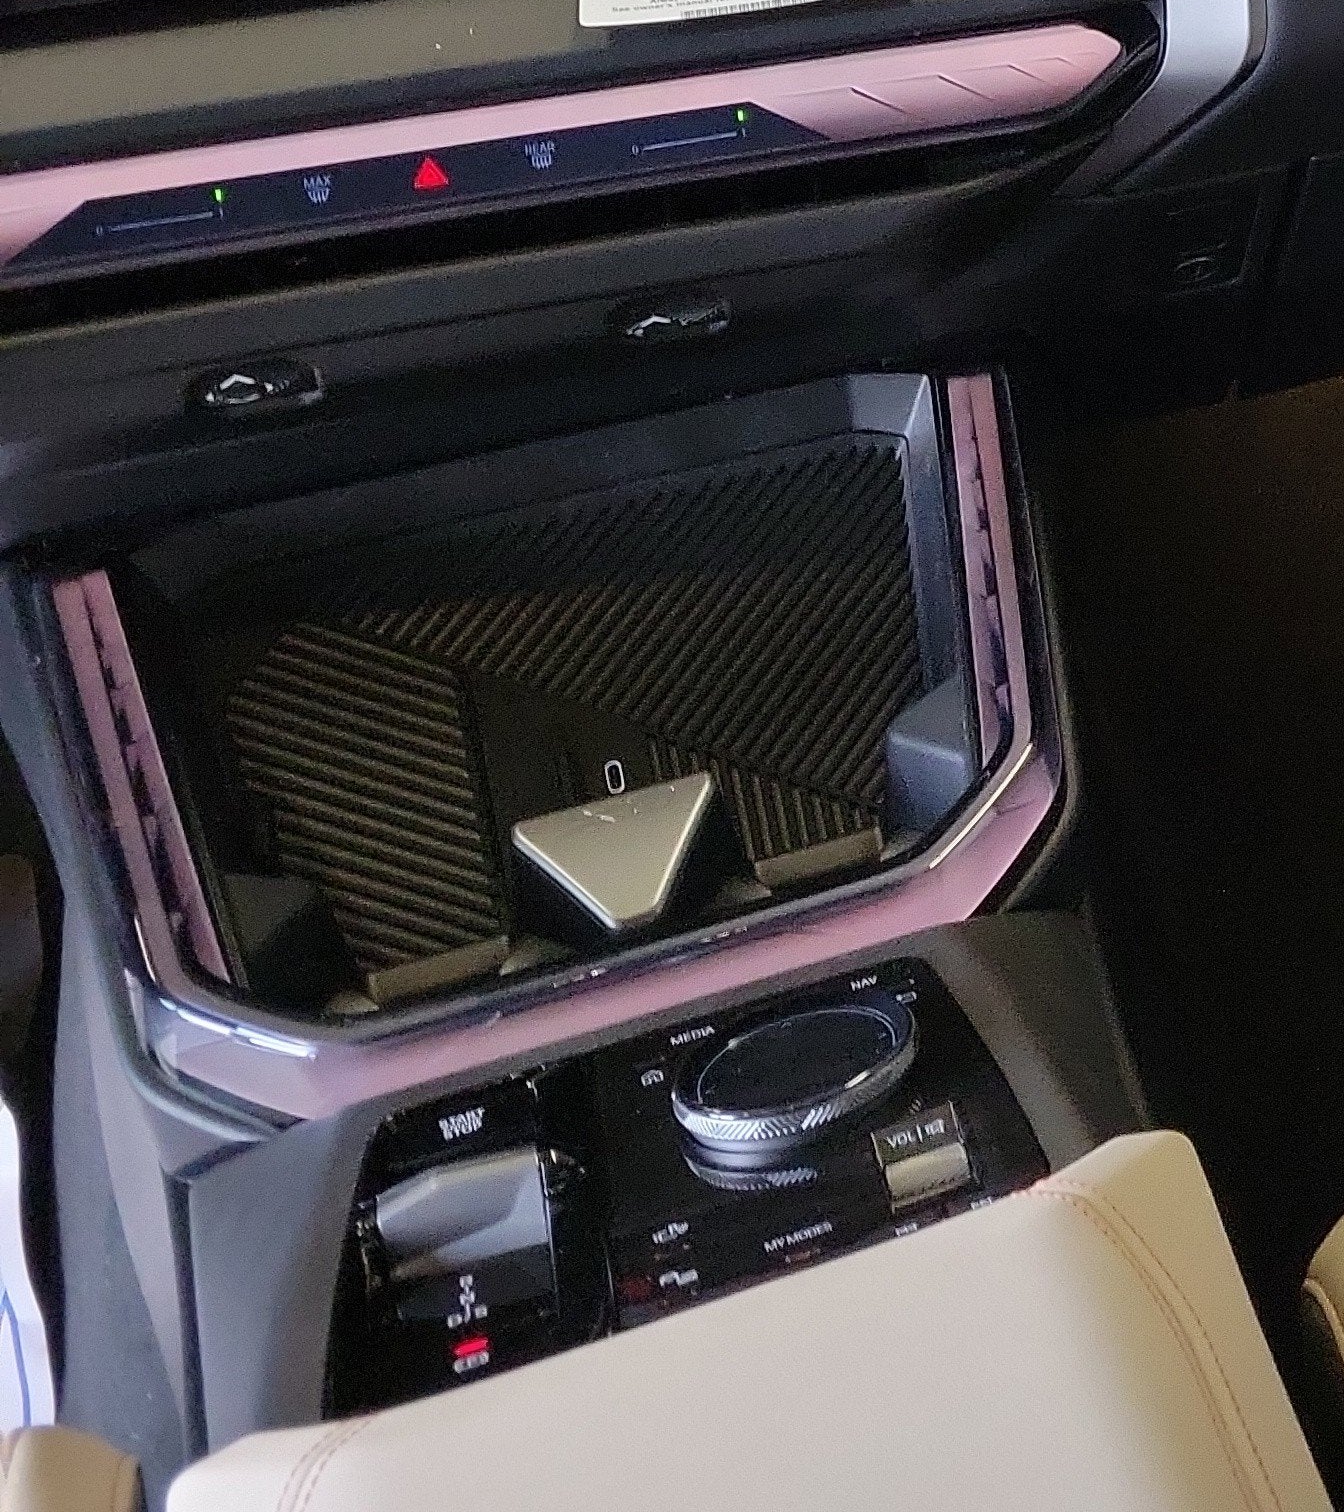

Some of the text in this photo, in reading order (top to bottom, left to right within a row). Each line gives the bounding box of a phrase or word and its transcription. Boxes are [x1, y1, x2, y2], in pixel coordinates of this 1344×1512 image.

[303, 174, 331, 189] MAX
[850, 975, 878, 991] NAV
[670, 1025, 715, 1047] MEDIA
[887, 1126, 914, 1148] VOL
